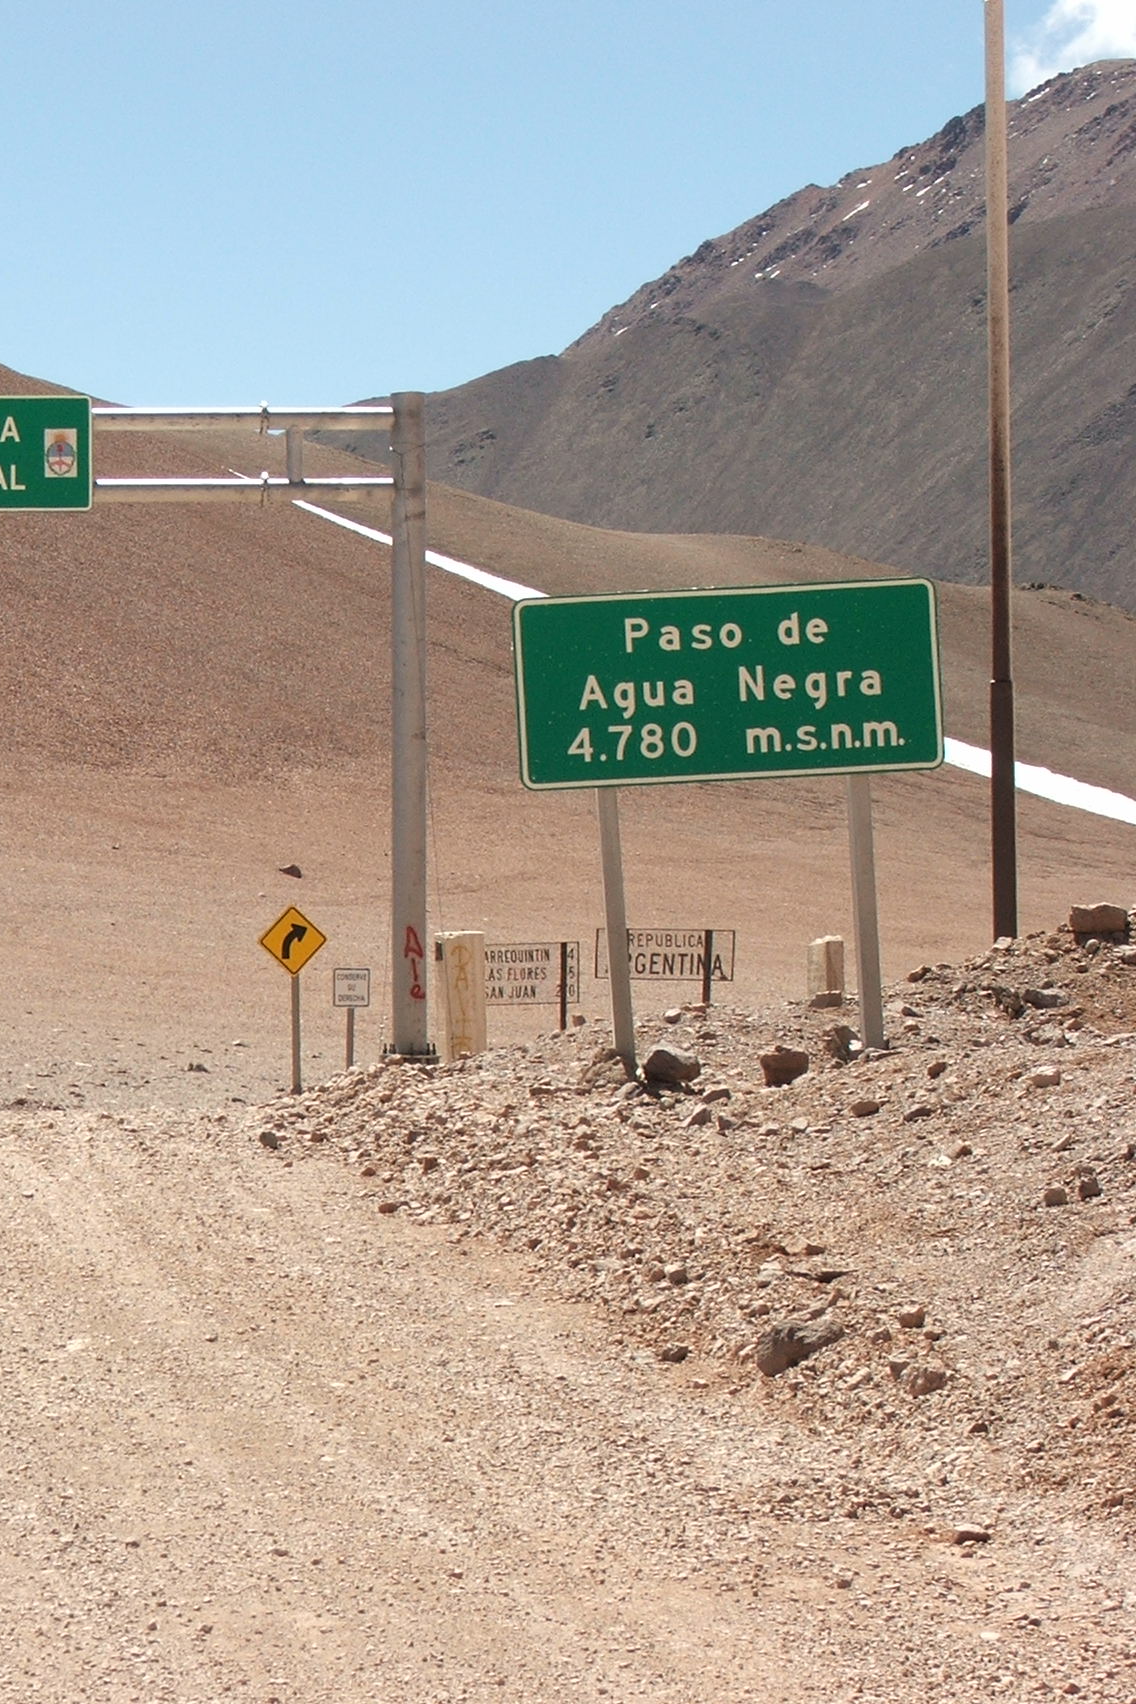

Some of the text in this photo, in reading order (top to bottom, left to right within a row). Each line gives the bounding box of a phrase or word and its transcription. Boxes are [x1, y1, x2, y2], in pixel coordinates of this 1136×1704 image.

[624, 612, 829, 653] Paso de
[579, 664, 883, 718] Agua Negra
[567, 720, 906, 763] 4.780 m.s.n.m.
[628, 932, 704, 947] REPUBLICA
[507, 966, 548, 981] FLORES
[605, 952, 725, 976] GENTINA
[508, 985, 537, 998] JUAN
